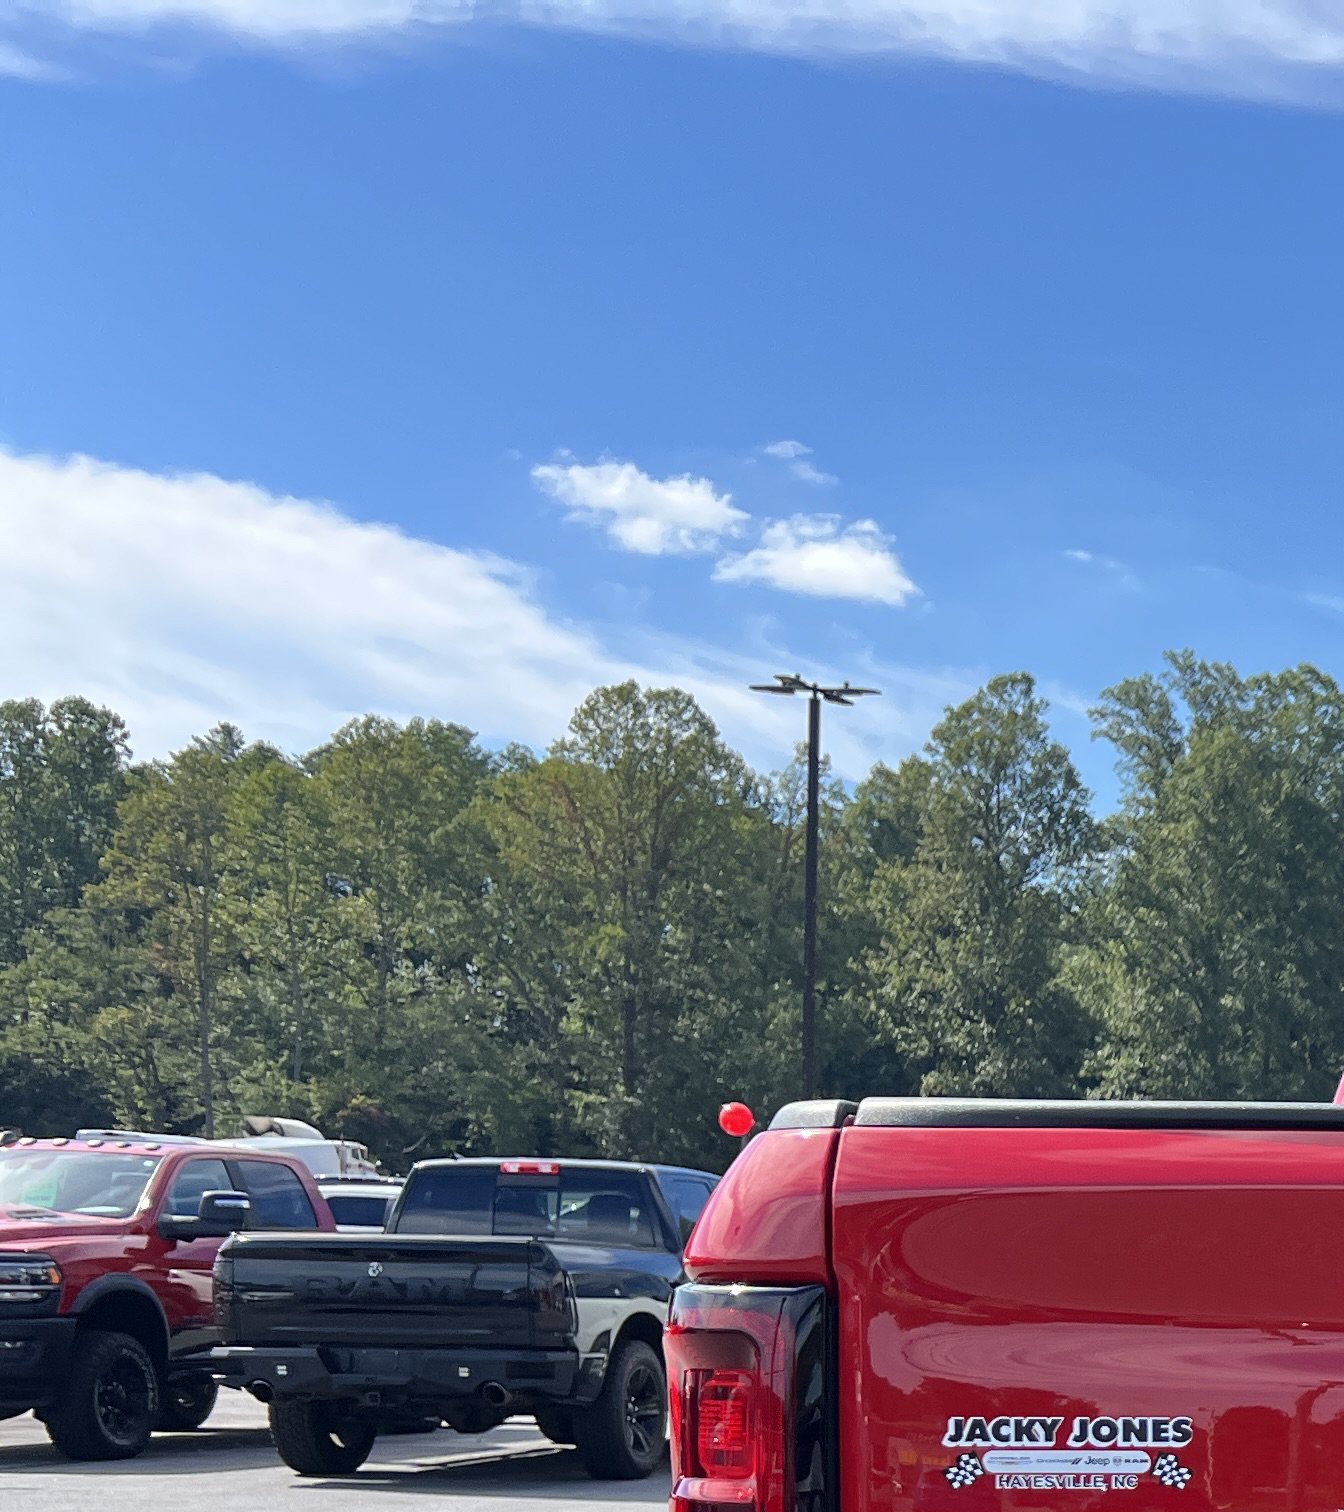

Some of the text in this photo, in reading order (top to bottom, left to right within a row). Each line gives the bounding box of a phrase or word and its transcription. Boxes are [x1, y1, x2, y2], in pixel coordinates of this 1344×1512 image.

[944, 1417, 1193, 1446] JACKY JONES
[1084, 1456, 1110, 1466] Jeep
[996, 1475, 1138, 1491] HAYESVILLE, NC
